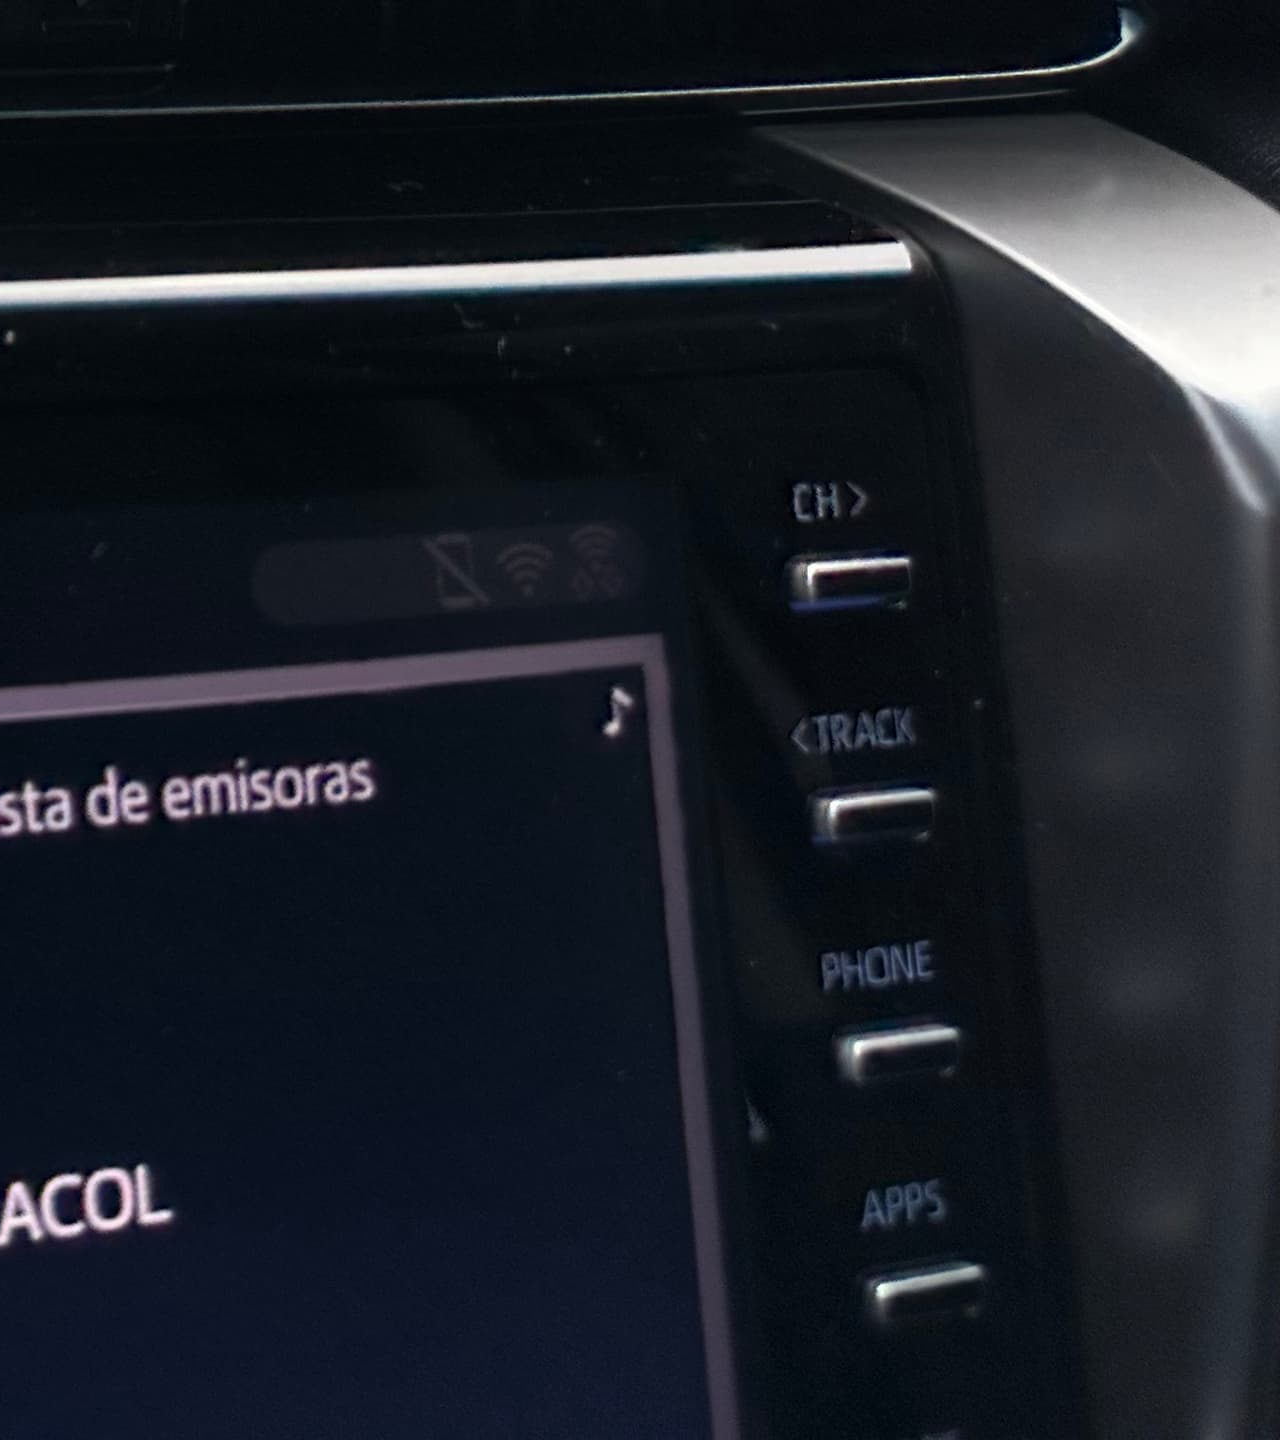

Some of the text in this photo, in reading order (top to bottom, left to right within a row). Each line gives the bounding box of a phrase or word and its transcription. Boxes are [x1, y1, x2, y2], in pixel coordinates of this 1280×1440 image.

[86, 766, 151, 825] de
[163, 758, 377, 816] emisoras
[821, 941, 933, 990] PHONE
[862, 1180, 947, 1229] APPS
